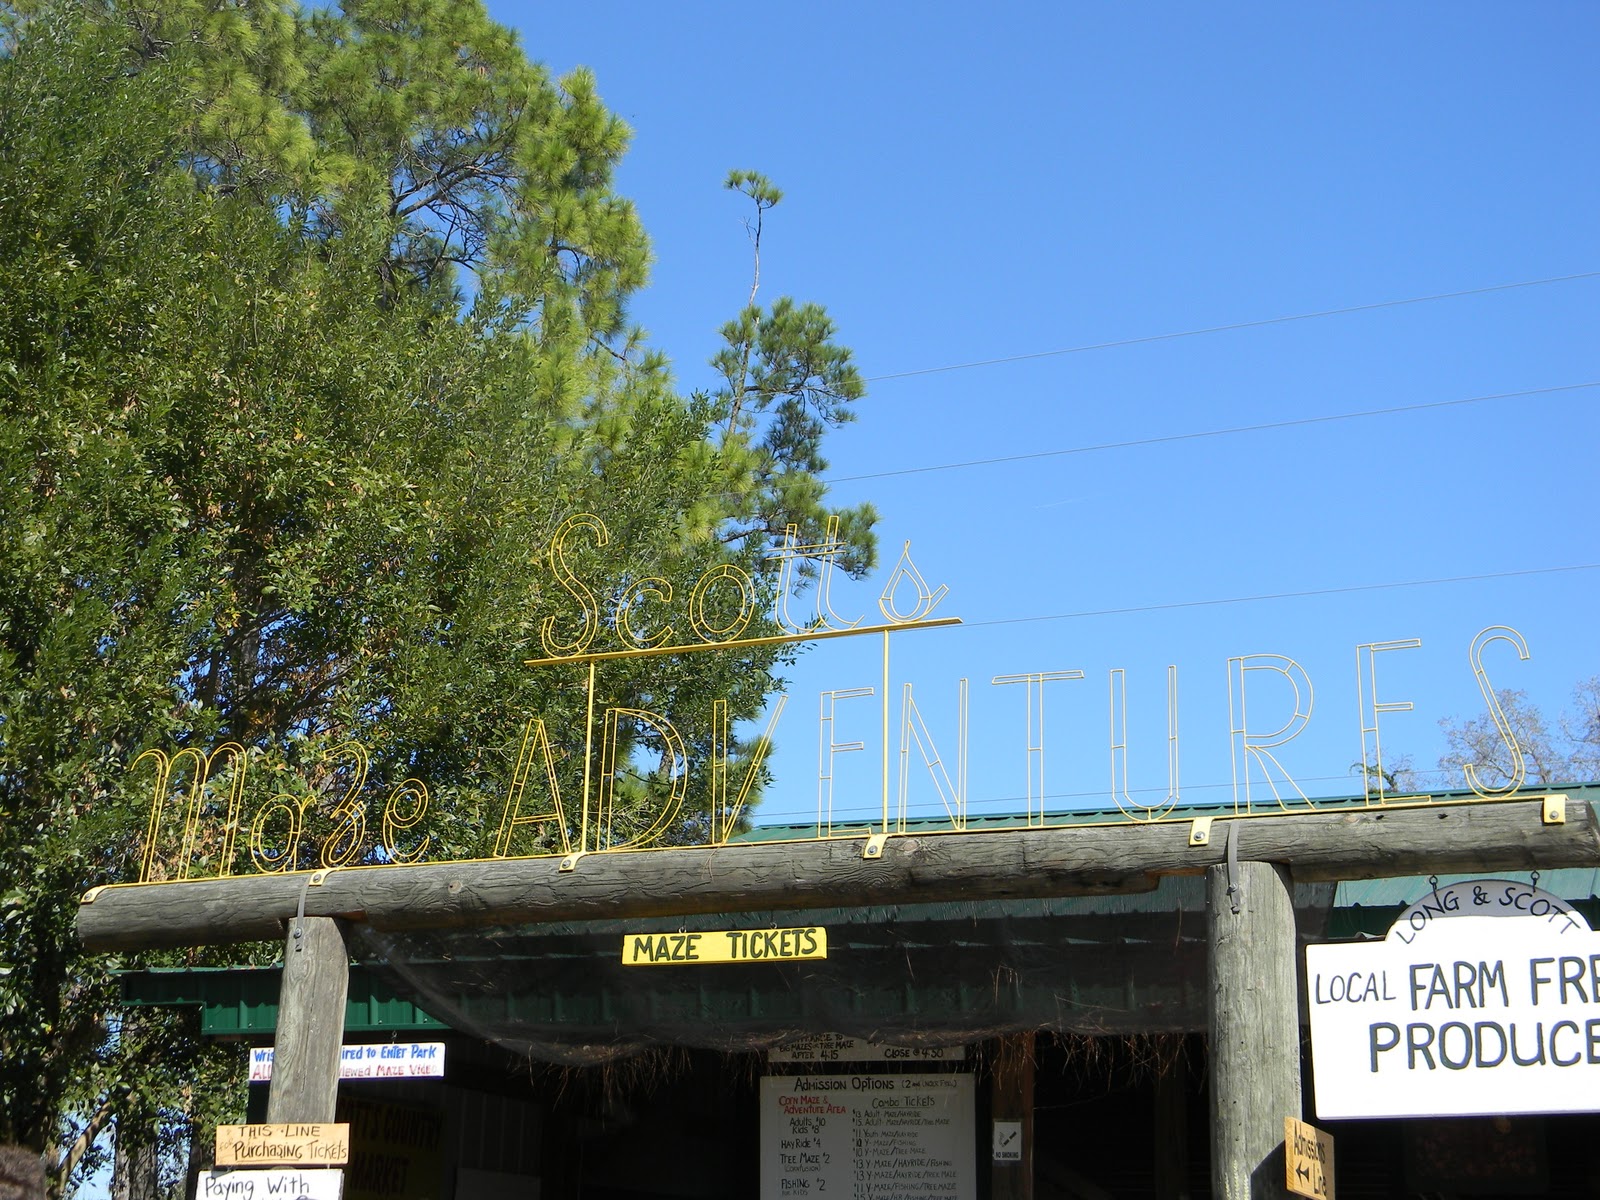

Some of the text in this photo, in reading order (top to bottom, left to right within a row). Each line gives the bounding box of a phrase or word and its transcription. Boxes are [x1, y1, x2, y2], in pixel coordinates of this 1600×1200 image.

[494, 625, 1531, 859] ADVENTURES
[1395, 885, 1581, 944] LONG & SCOTT
[633, 928, 818, 962] MAZE TICKETS
[1315, 954, 1600, 1011] LOCAL FARM FRE
[1369, 1018, 1600, 1073] PRODUCE
[367, 1047, 376, 1058] to
[791, 1051, 815, 1059] AFTER
[884, 1048, 910, 1058] CLOSE
[376, 1064, 404, 1076] MAZE
[800, 1095, 820, 1105] MAZE
[823, 1095, 828, 1104] &
[238, 1125, 272, 1138] THIS
[799, 1152, 820, 1164] MAZE
[205, 1173, 310, 1200] Paying With
